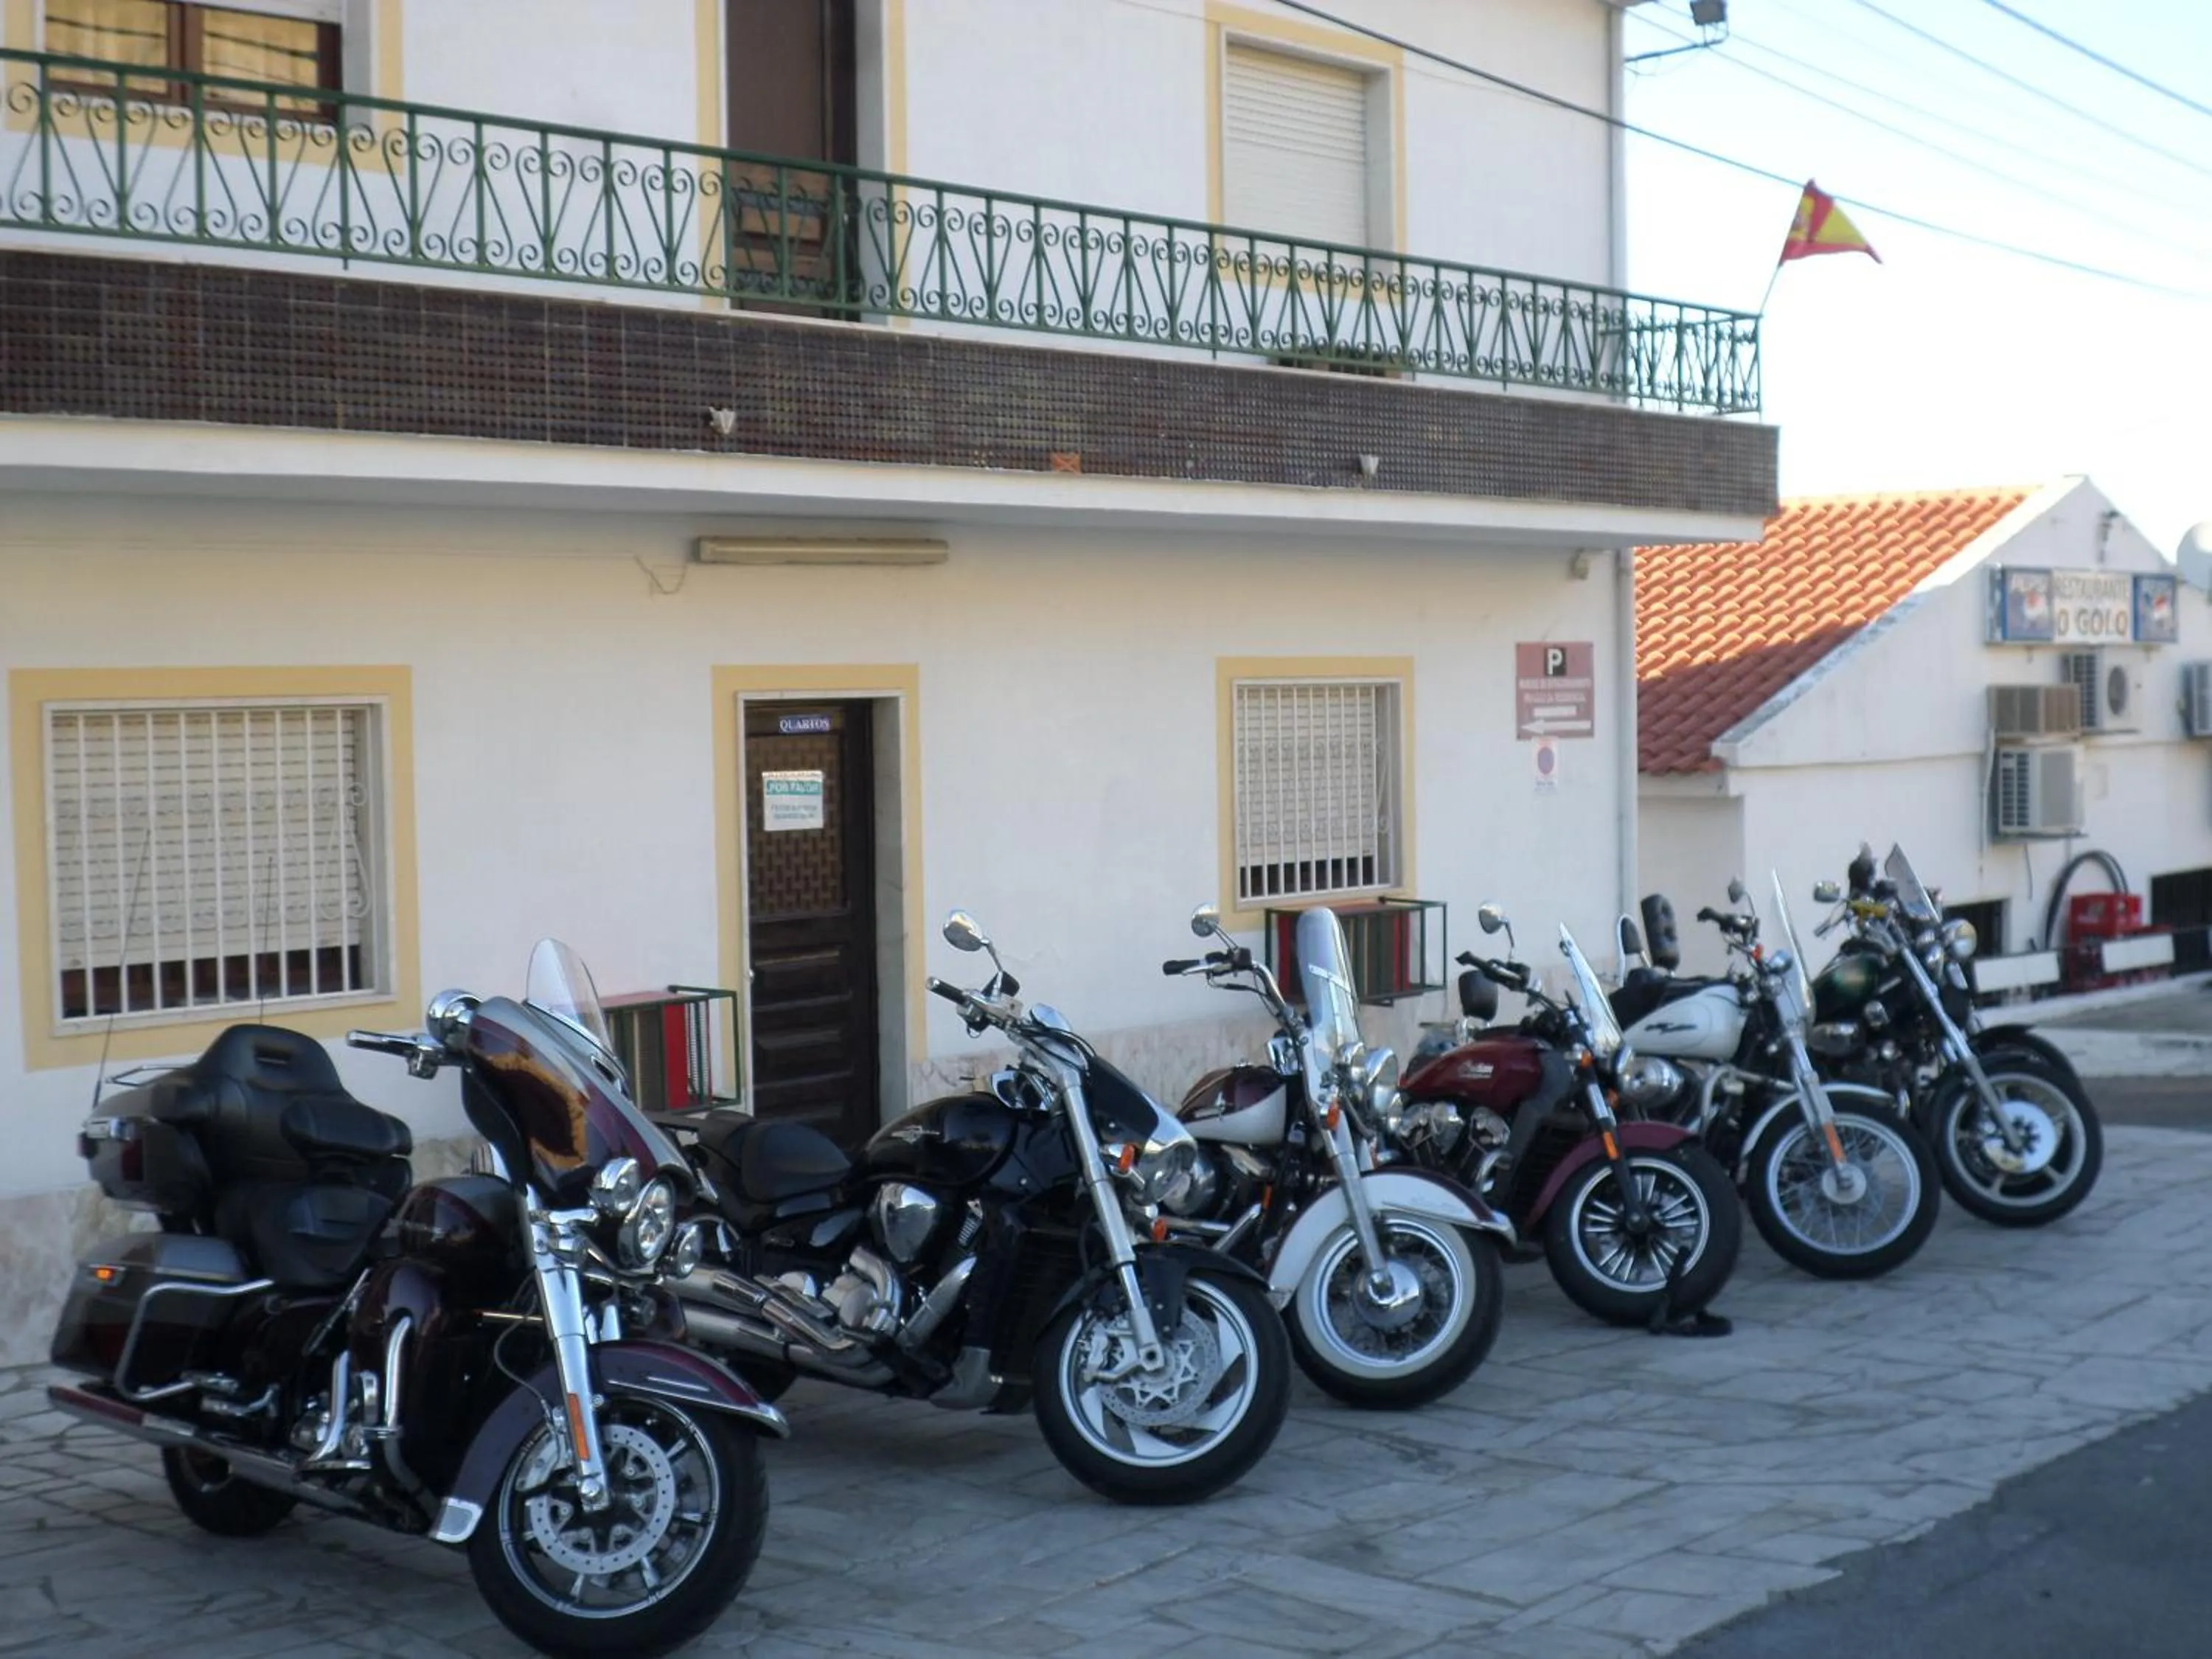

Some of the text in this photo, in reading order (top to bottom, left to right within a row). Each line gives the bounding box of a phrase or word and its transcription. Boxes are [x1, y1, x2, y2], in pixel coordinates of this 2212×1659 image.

[2076, 608, 2128, 636] GOLO
[1548, 648, 1563, 675] P
[779, 719, 830, 732] QUARTOS
